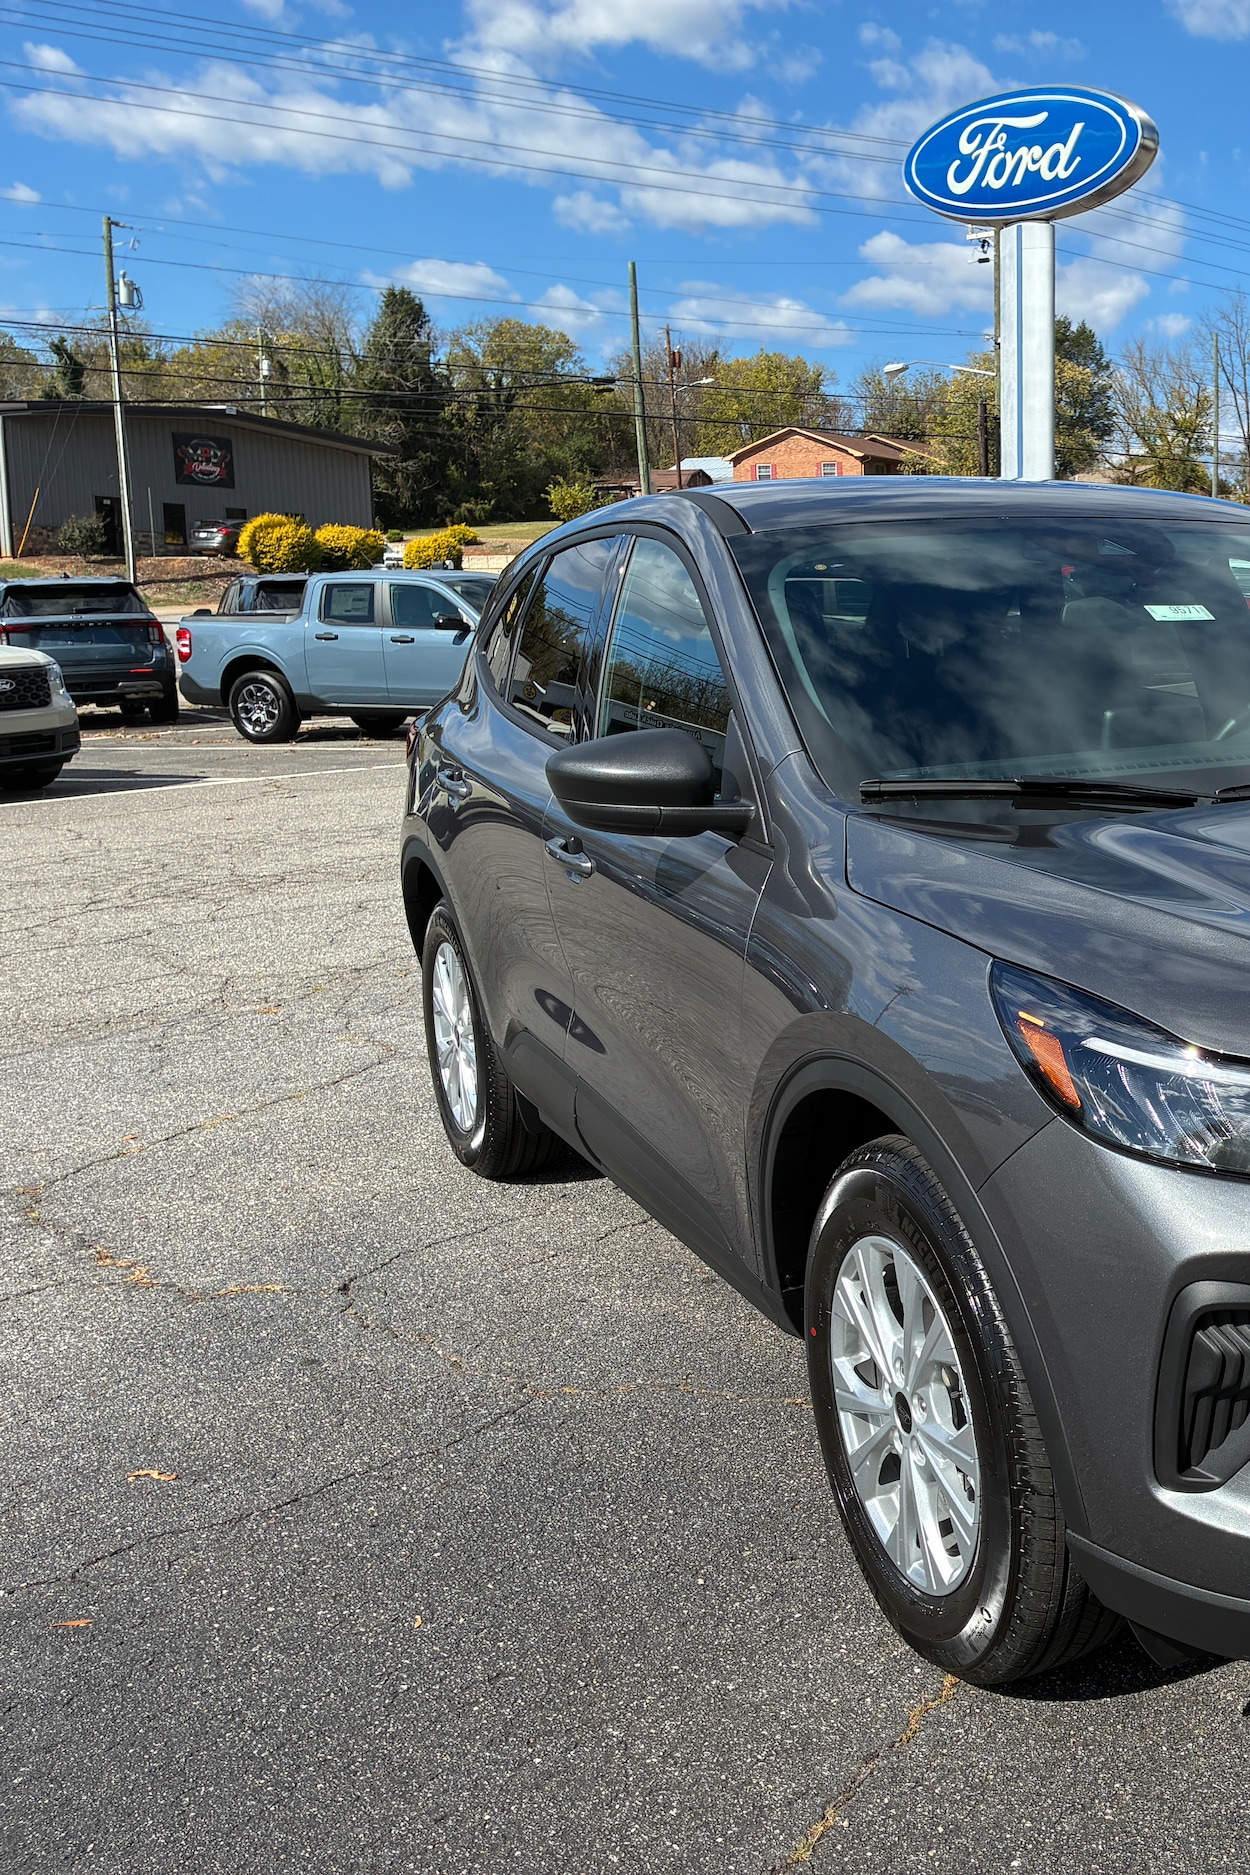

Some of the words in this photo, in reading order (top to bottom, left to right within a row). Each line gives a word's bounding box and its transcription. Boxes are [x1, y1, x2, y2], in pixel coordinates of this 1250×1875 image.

[946, 111, 1085, 195] Ford
[1169, 606, 1201, 614] 9571
[901, 1217, 964, 1335] MICHELIN
